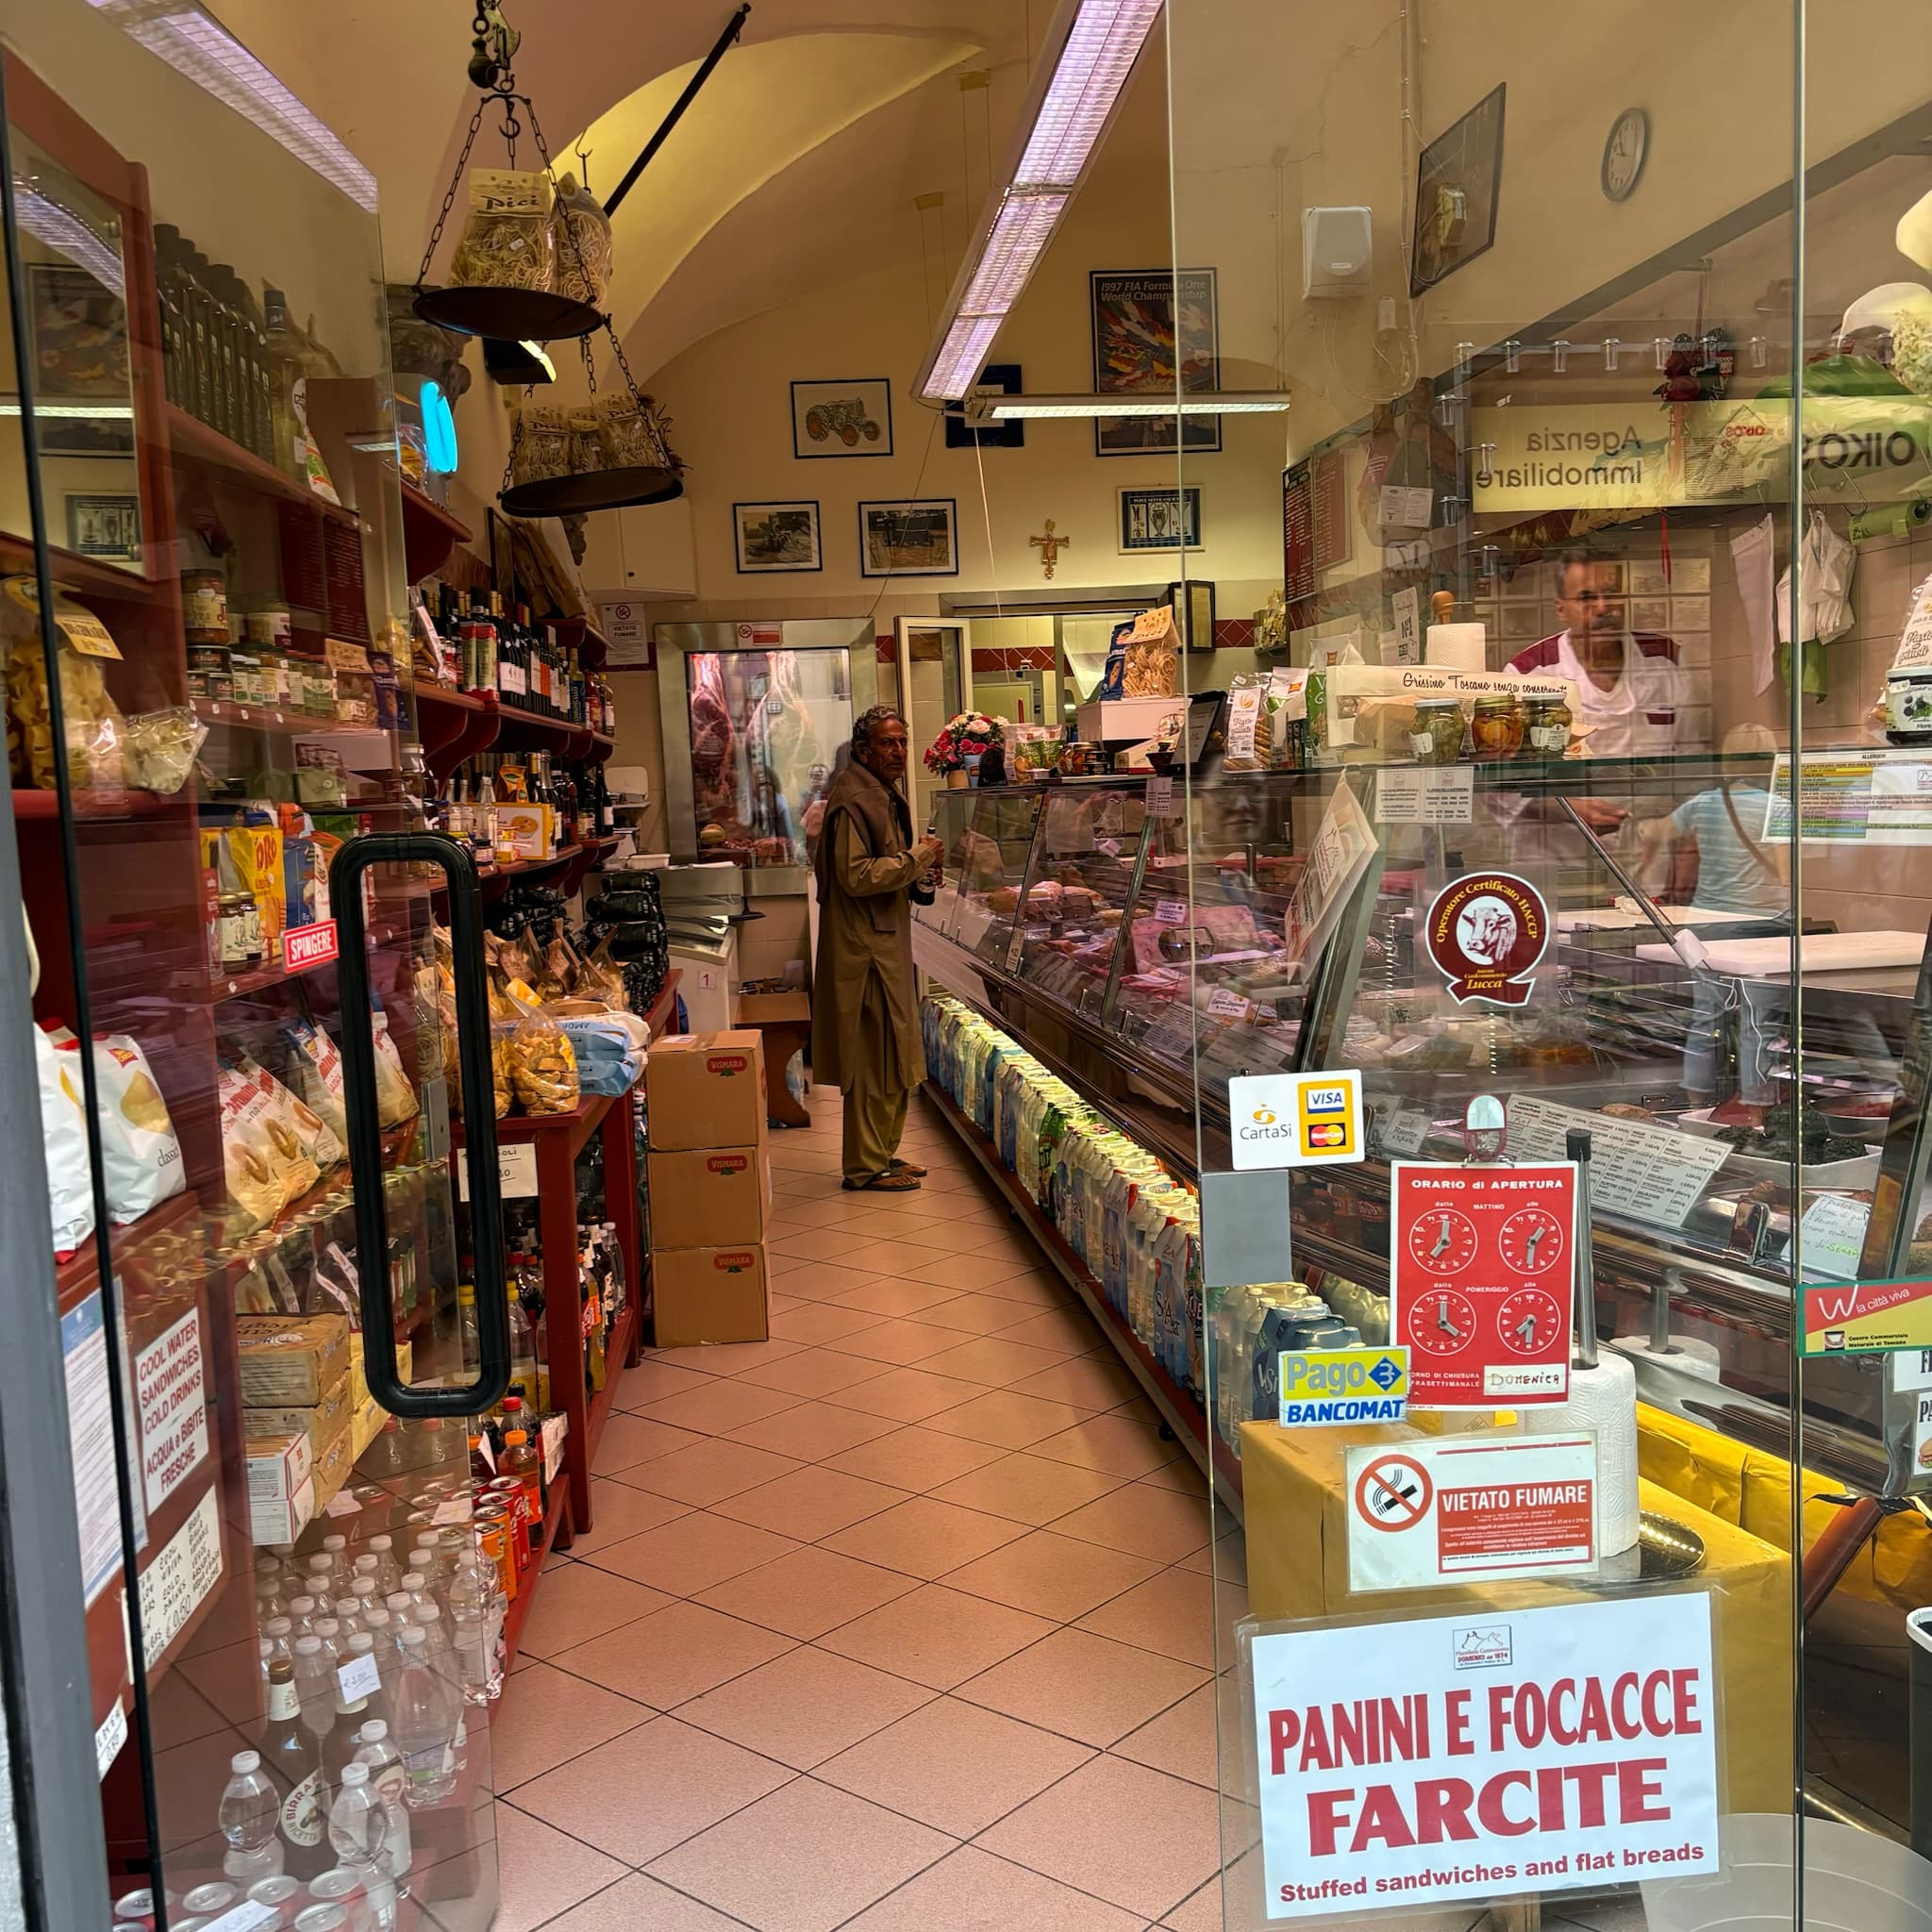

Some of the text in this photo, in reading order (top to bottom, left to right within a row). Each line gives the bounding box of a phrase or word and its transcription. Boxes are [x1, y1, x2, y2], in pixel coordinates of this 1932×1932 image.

[1101, 292, 1131, 302] World
[1102, 279, 1206, 291] 1997 FIA Formua One
[1404, 673, 1445, 689] Grissino
[1449, 675, 1491, 690] Toscano
[1493, 682, 1519, 693] senza
[1436, 879, 1538, 942] Operatore Certificato HACCP
[291, 930, 332, 960] SPINGERE
[1466, 979, 1502, 989] Lucca
[710, 1059, 743, 1070] VISMARA
[1312, 1092, 1342, 1105] VISA
[1240, 1124, 1292, 1140] CartaSi
[710, 1158, 744, 1169] VISMARA
[1411, 1179, 1563, 1189] ORARIO di APERTURA
[717, 1256, 751, 1266] VISMARA
[1818, 1283, 1909, 1320] W la città viva
[140, 1350, 167, 1381] COOL
[167, 1319, 197, 1359] WATER
[141, 1344, 200, 1409] SANDWICHES
[1287, 1357, 1366, 1396] Pago
[144, 1370, 202, 1435] COLD DRINKS
[1287, 1399, 1405, 1424] BANCOMAT
[146, 1406, 205, 1479] ACQUA e BIBITE
[160, 1441, 196, 1493] FRESCHE
[1442, 1485, 1588, 1513] VIETATO FUMARE
[1268, 1668, 1703, 1775] PANINI E FOCACCE
[286, 1784, 313, 1821] BIRRA
[1307, 1757, 1672, 1857] FARCITE
[1279, 1843, 1705, 1903] Stuffed sandwiches and flat breads
